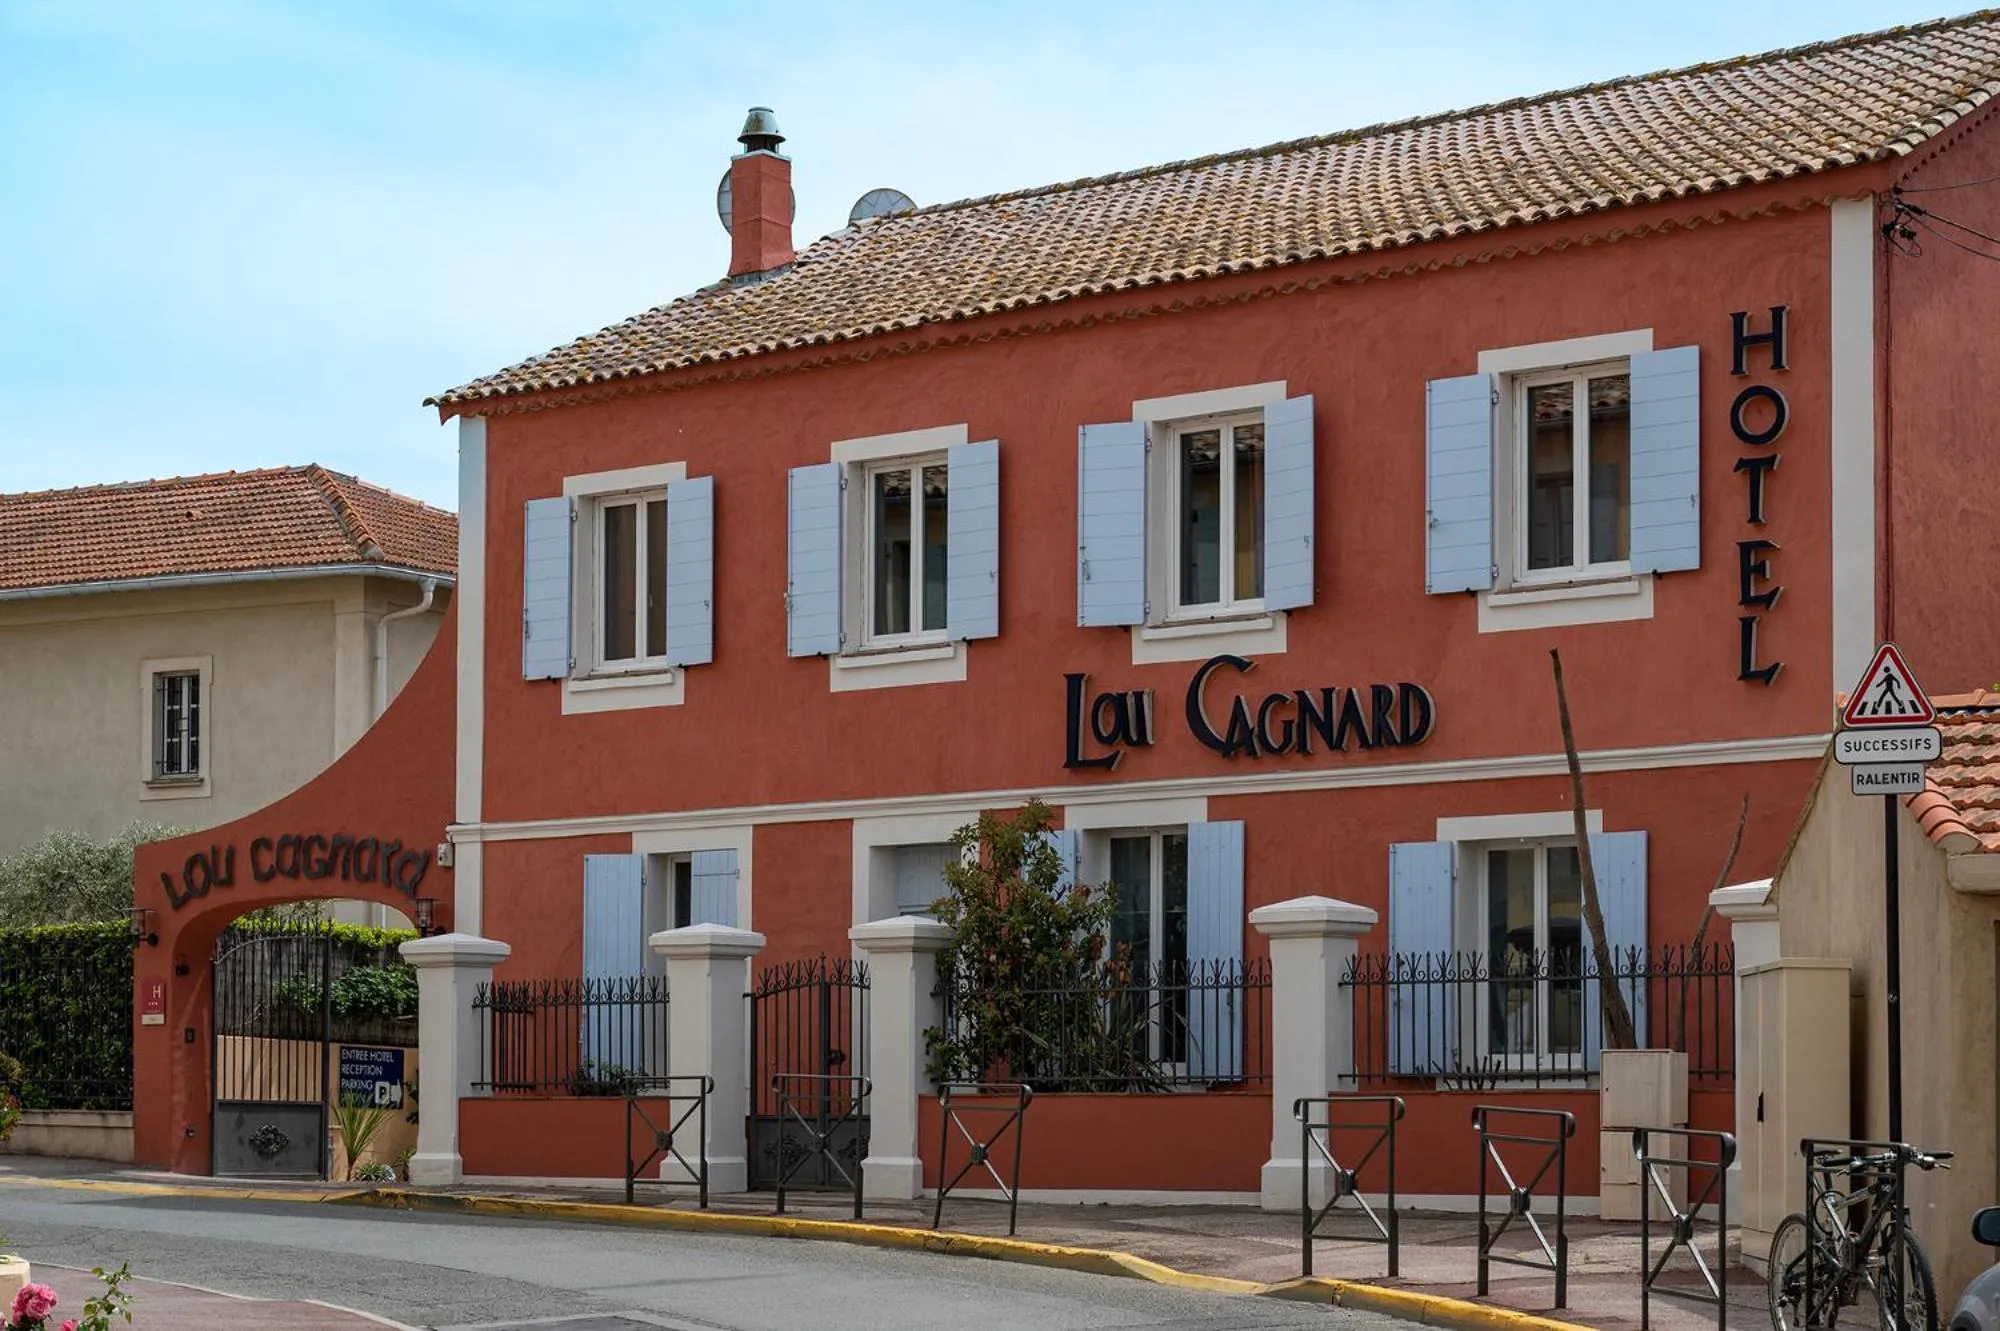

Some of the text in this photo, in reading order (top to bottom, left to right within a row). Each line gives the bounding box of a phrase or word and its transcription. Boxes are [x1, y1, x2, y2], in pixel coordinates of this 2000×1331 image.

[1729, 305, 1791, 687] HOTEL
[1844, 738, 1932, 753] SUCCESSIFS
[1856, 772, 1920, 786] RALENTIR
[152, 985, 161, 999] H
[341, 1049, 394, 1063] ENTREE HOTEL
[341, 1063, 383, 1076] RECEPTION
[341, 1078, 374, 1090] PARKING
